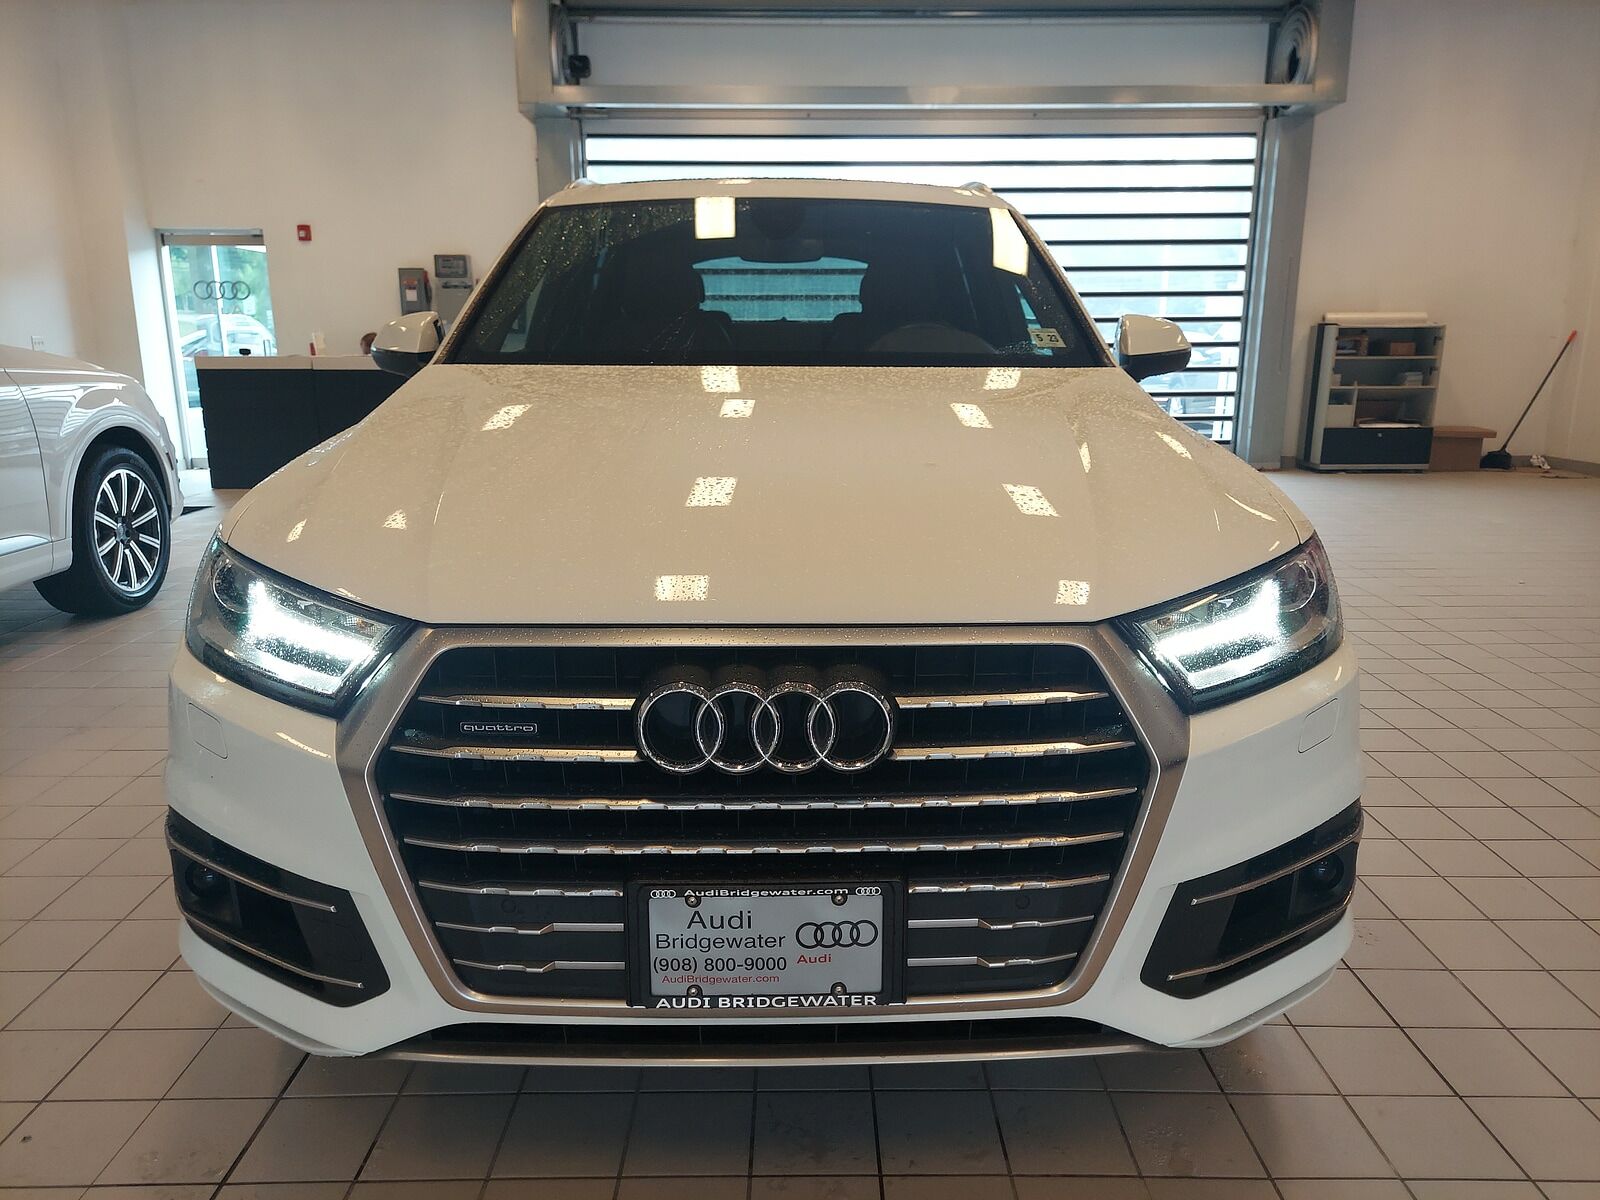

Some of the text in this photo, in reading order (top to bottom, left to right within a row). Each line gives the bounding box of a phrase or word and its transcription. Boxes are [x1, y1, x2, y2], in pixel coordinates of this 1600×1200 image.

[463, 724, 534, 732] quattro
[684, 888, 849, 897] AudiBridgewater.com
[686, 910, 753, 930] Audi
[655, 933, 786, 953] Bridgewater
[797, 953, 832, 964] Audi
[653, 956, 787, 974] (908) 800-9000
[661, 974, 780, 985] AudiBridgewater.com
[656, 995, 877, 1009] AUDI BRIDGEWATER
